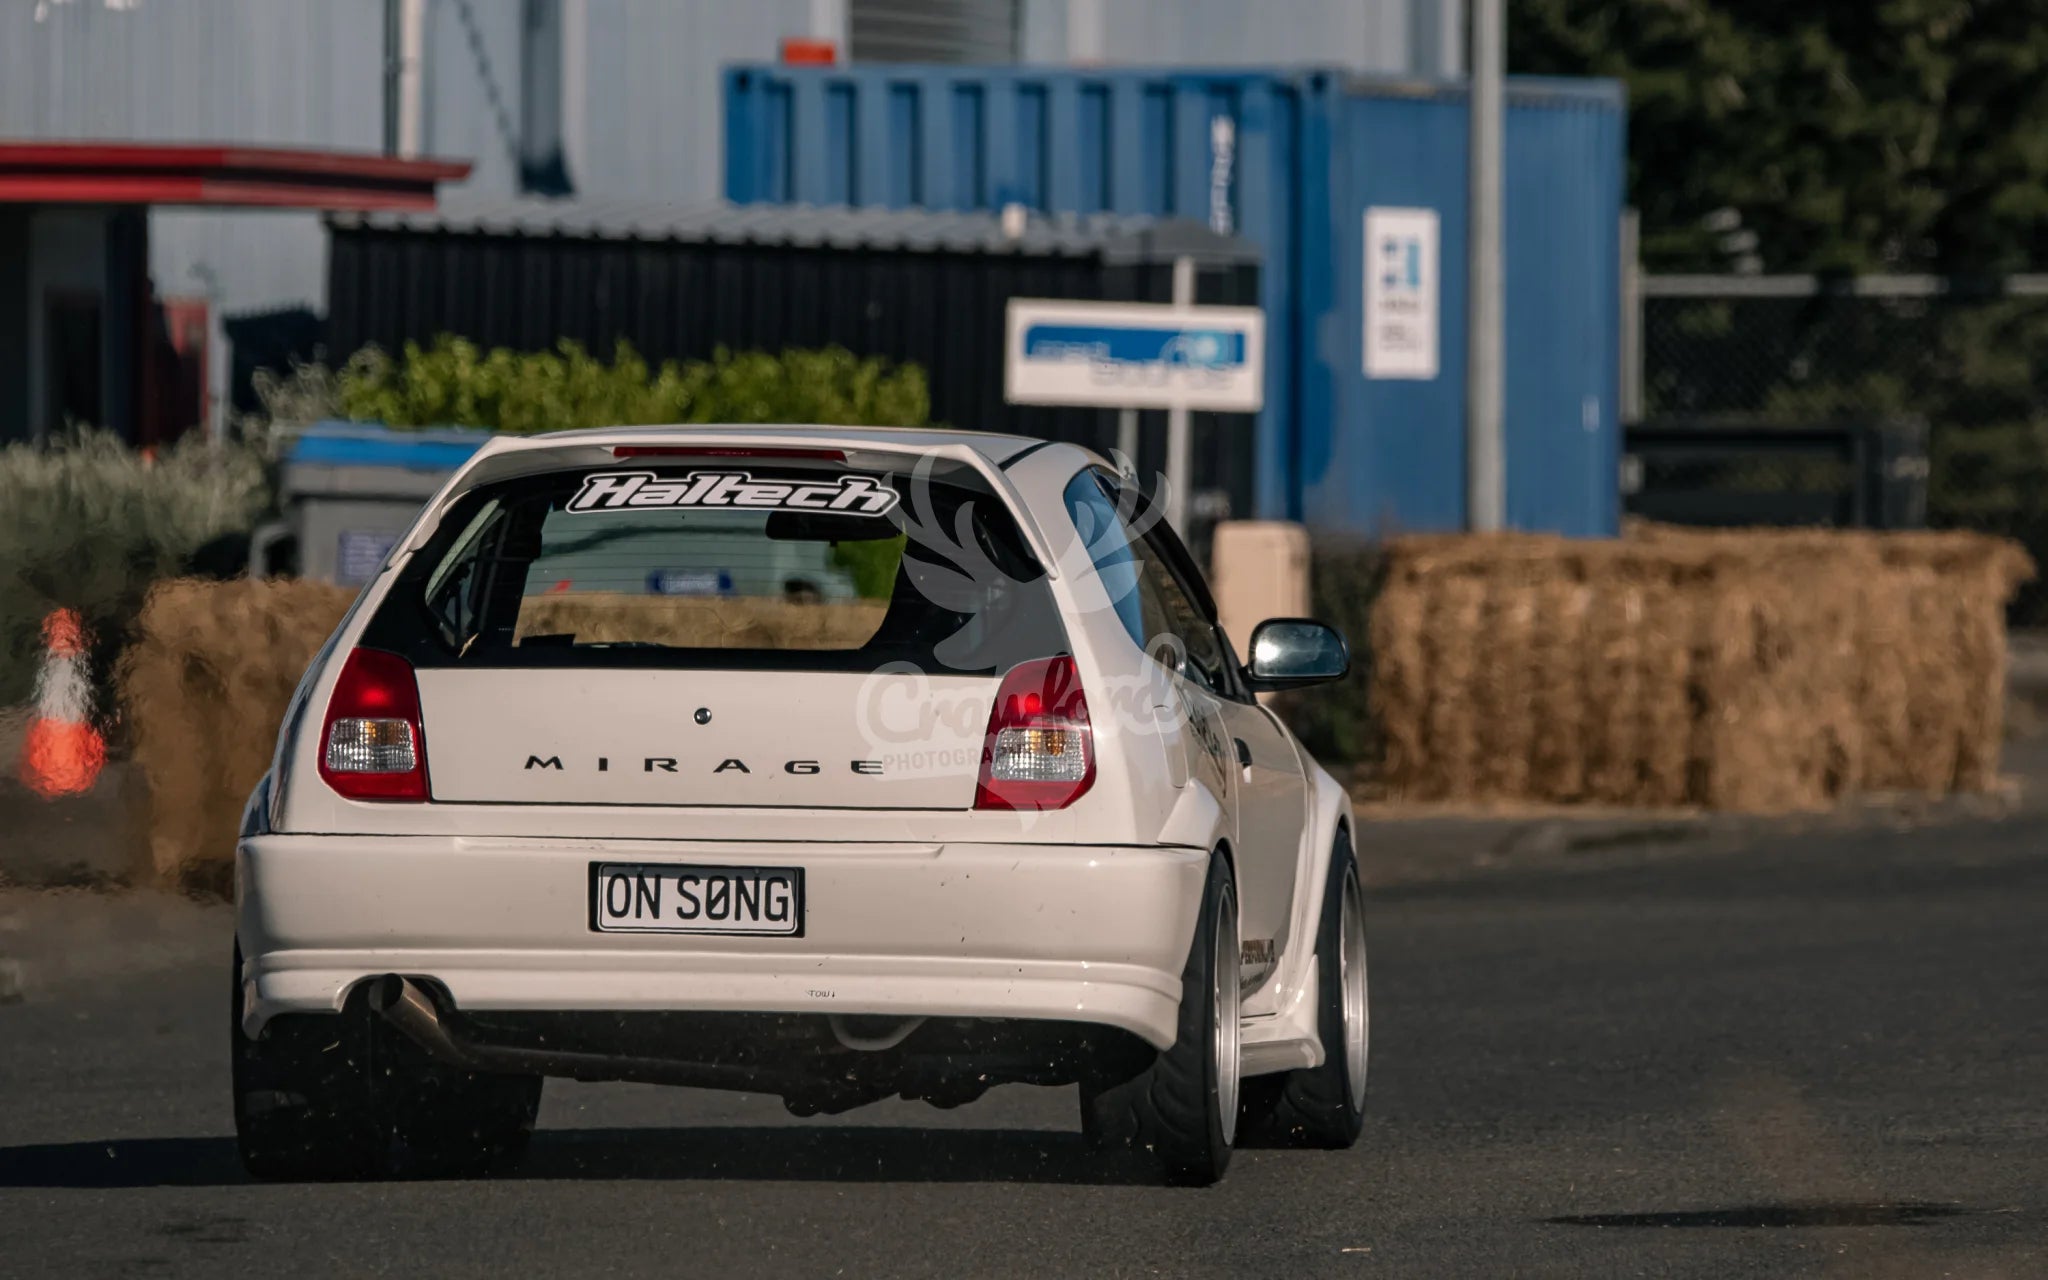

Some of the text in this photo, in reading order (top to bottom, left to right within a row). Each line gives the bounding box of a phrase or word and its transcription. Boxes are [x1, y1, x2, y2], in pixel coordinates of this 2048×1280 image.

[573, 473, 892, 512] Haltech
[523, 754, 885, 775] MIRAGE
[606, 872, 662, 919] ON
